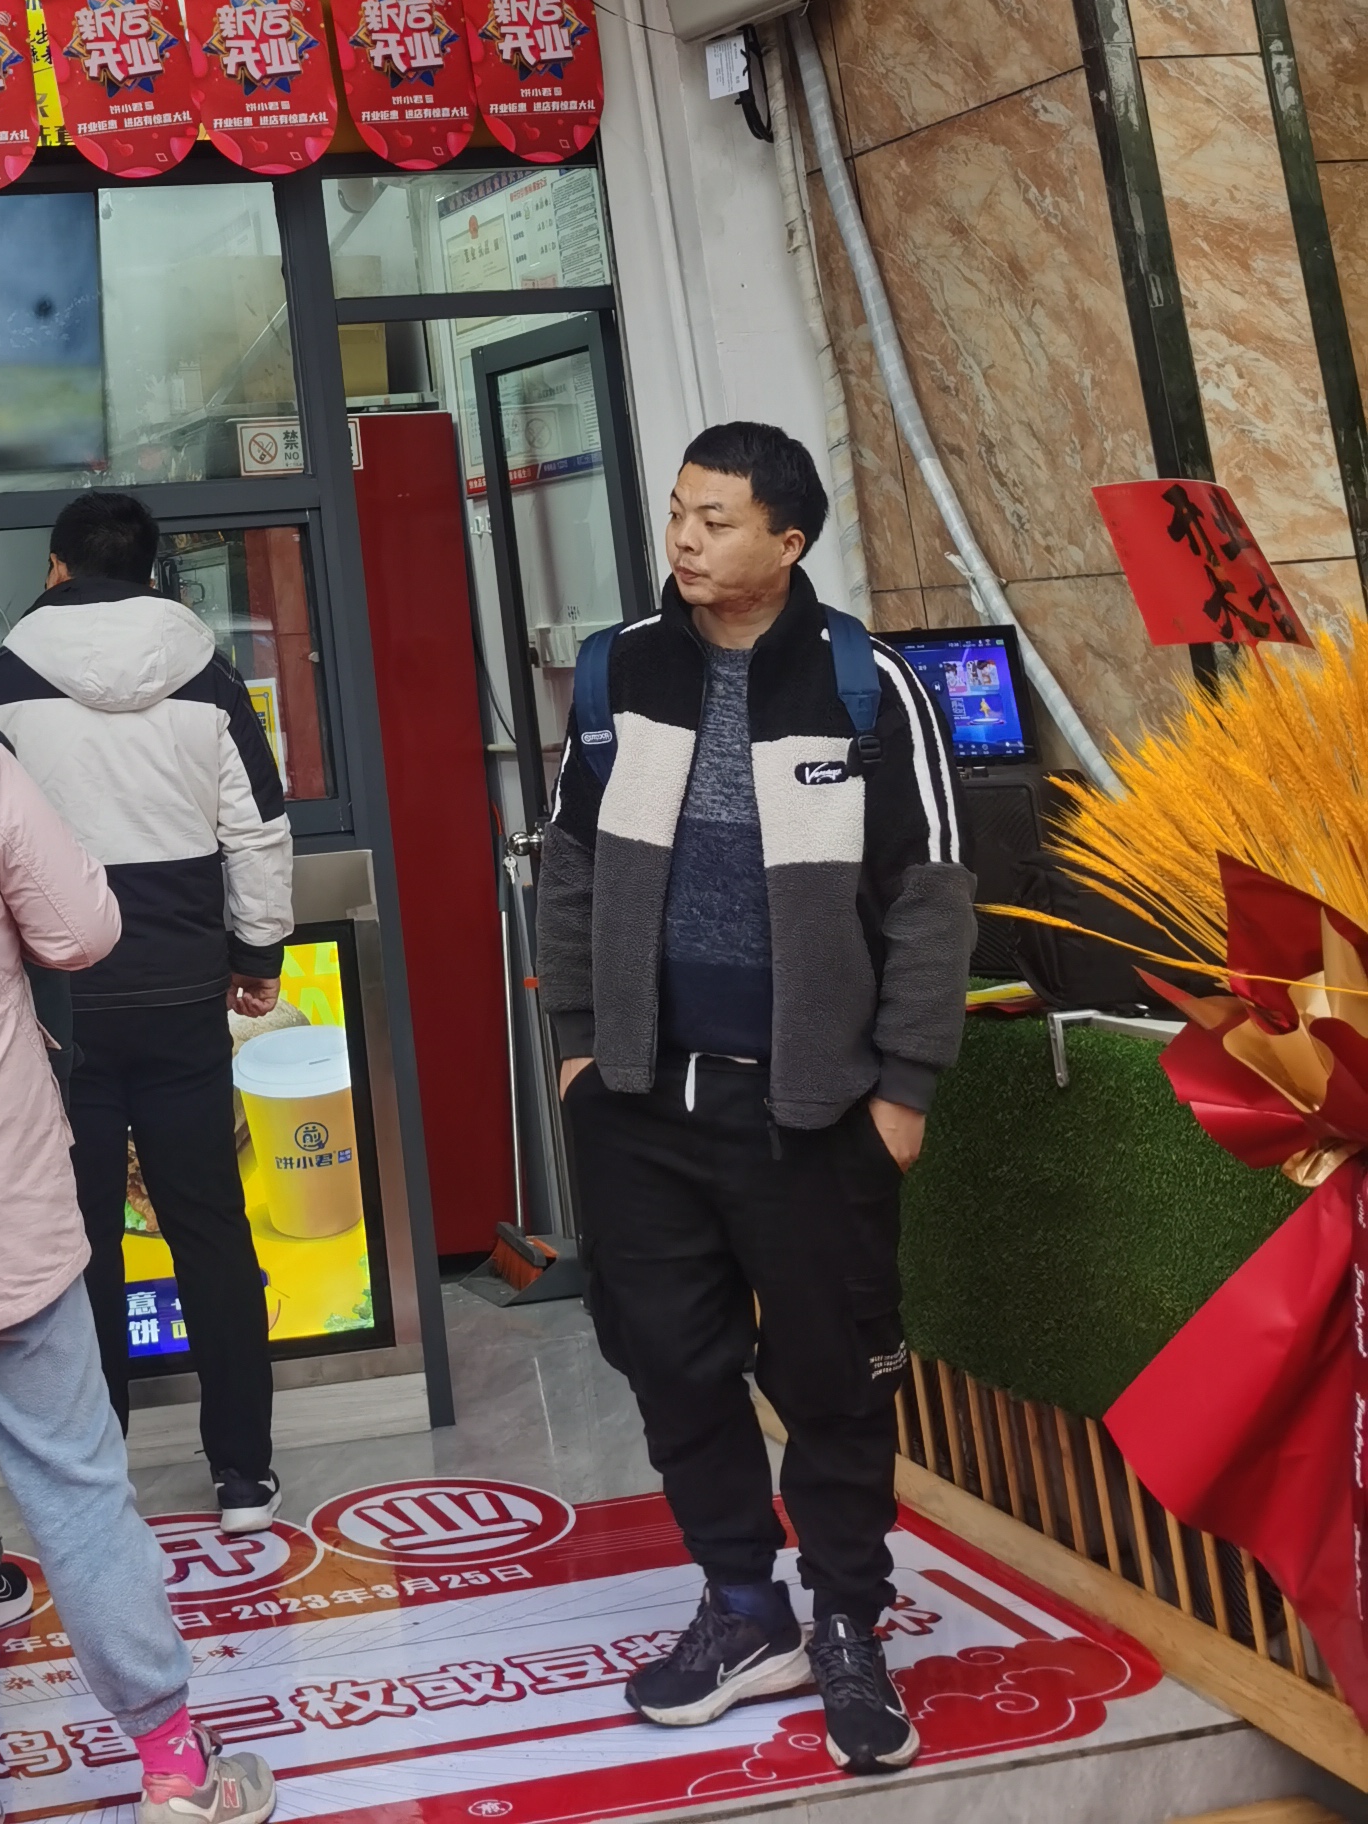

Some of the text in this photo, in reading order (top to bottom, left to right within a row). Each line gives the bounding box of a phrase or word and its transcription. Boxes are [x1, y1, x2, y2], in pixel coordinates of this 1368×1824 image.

[75, 3, 150, 40] 新店
[218, 2, 290, 38] 新店
[84, 38, 162, 82] 开业
[223, 38, 302, 78] 开业
[369, 32, 444, 73] 开业
[498, 25, 573, 66] 开业
[283, 429, 299, 450] 禁
[285, 452, 300, 460] NO
